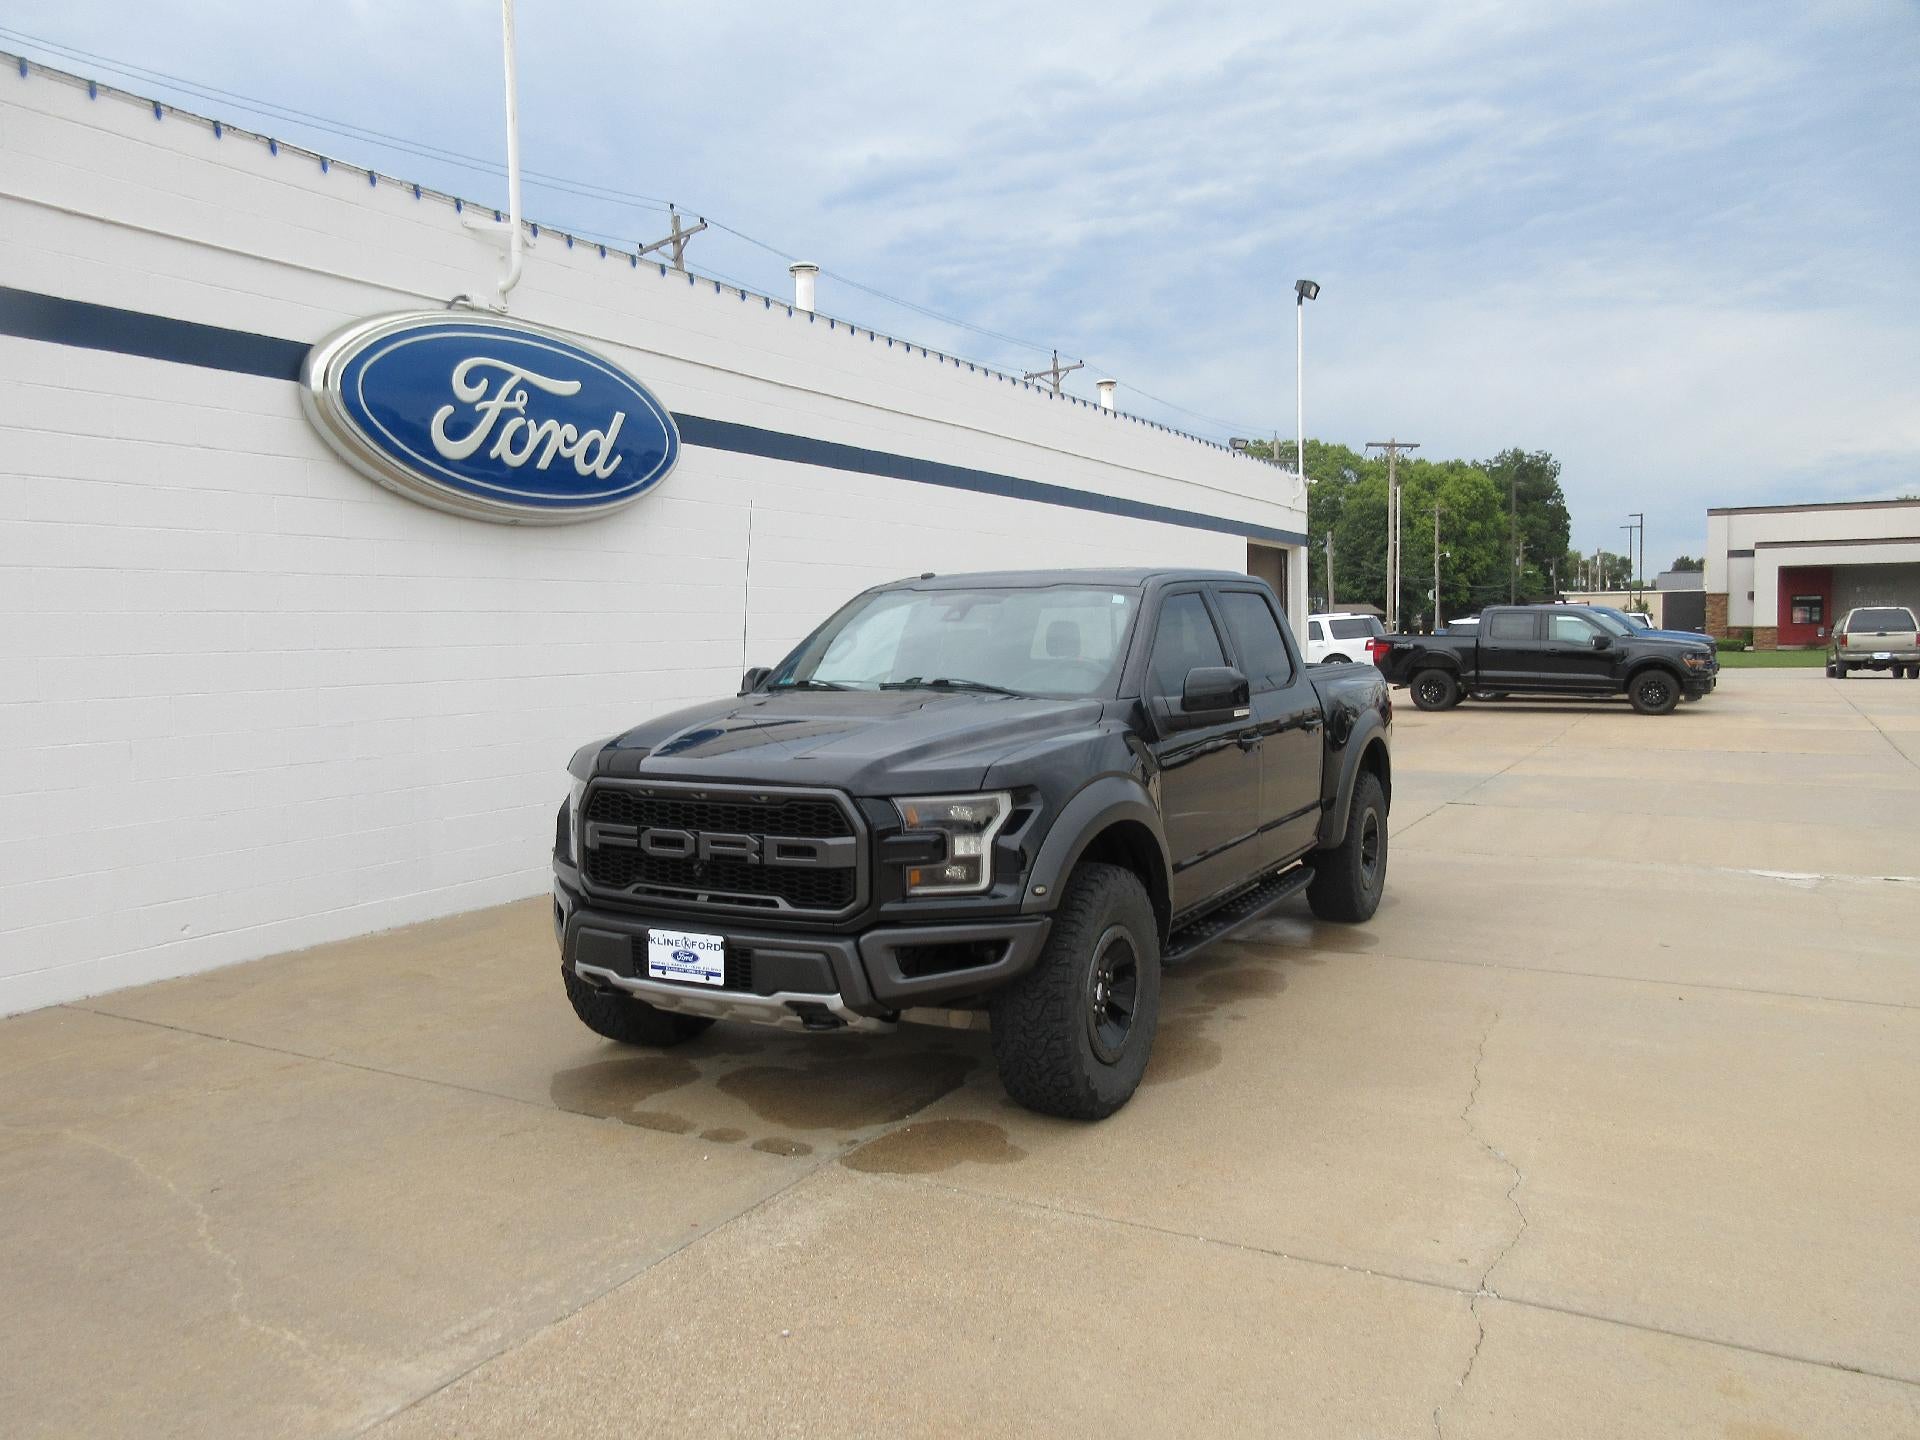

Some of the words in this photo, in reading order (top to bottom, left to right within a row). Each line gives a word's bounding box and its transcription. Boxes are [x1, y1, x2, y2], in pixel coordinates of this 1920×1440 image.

[430, 356, 626, 480] Ford
[584, 820, 857, 868] FORD
[650, 936, 681, 948] KLINE
[691, 941, 721, 952] FORD
